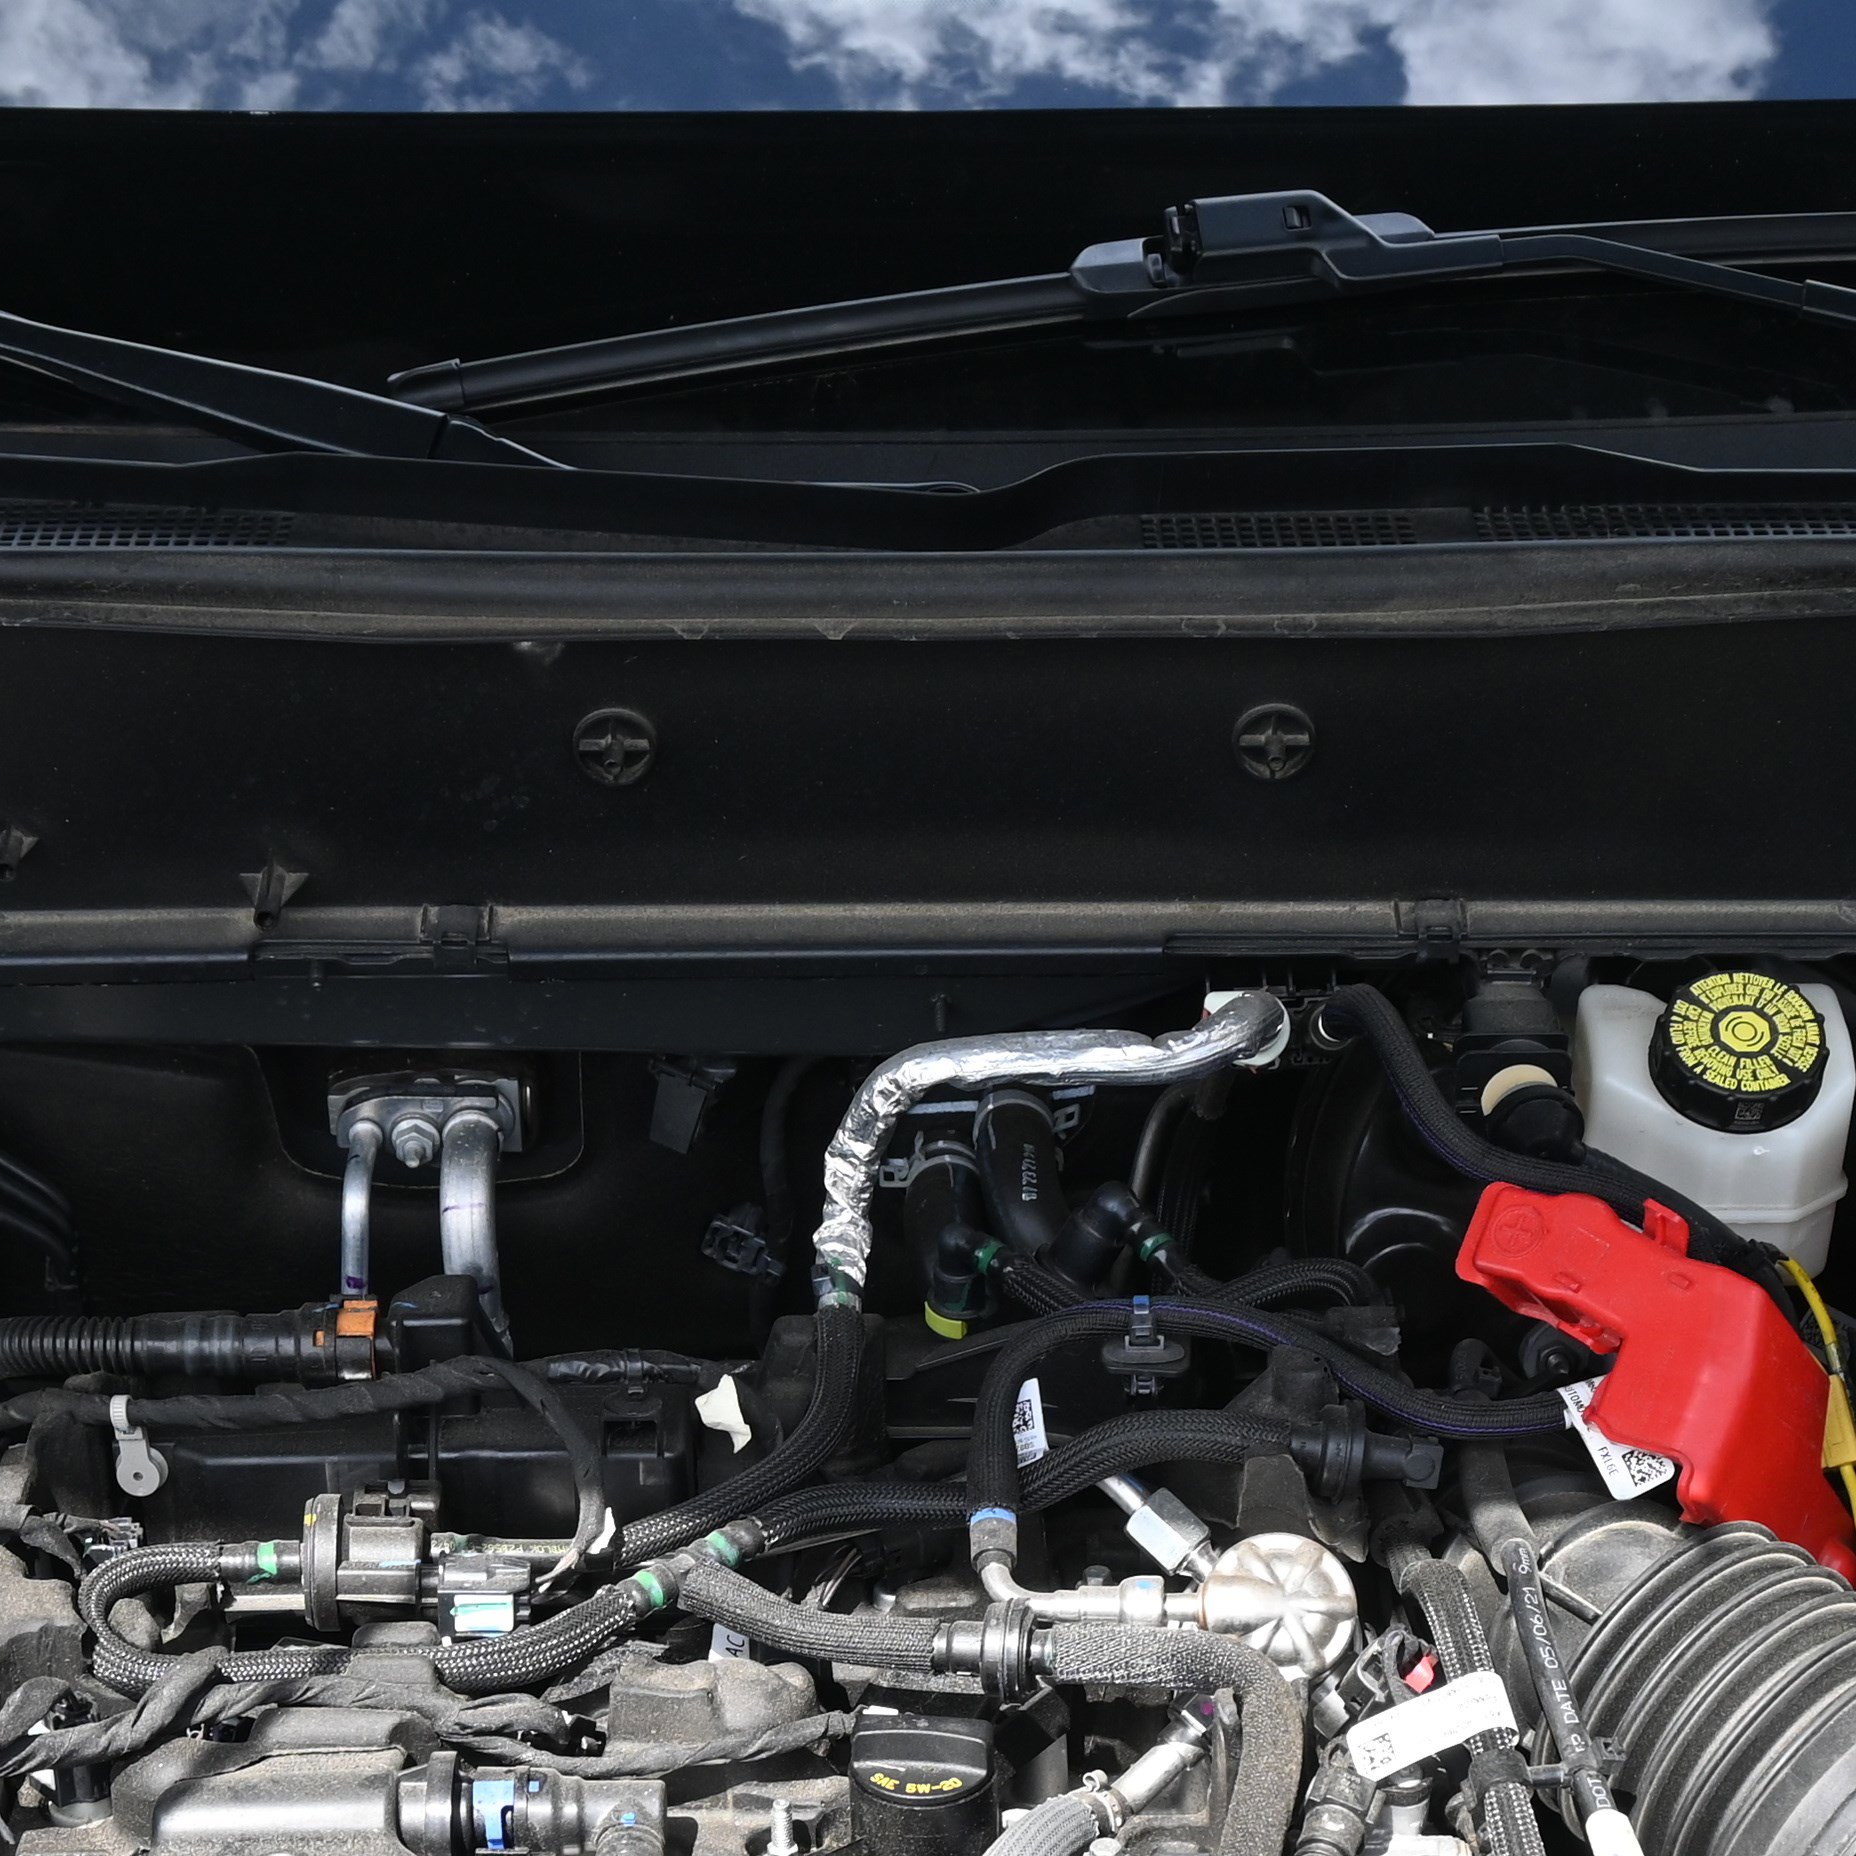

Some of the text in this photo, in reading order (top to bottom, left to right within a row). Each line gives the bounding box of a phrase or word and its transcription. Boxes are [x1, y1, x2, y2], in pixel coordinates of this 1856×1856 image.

[1732, 972, 1776, 989] NETTOYER
[1675, 1045, 1695, 1068] FROM
[1703, 1069, 1738, 1091] SEALED
[1740, 1073, 1791, 1092] CONTAINER
[1707, 1045, 1737, 1068] CLEAN
[1739, 1055, 1773, 1070] FILLER
[1736, 1068, 1755, 1081] USE
[1756, 1064, 1780, 1080] ONLY
[1522, 1587, 1558, 1669] 05/06/21
[1551, 1679, 1580, 1724] DATE
[870, 1772, 963, 1794] SAE 5W-20
[1587, 1774, 1611, 1809] DOT
